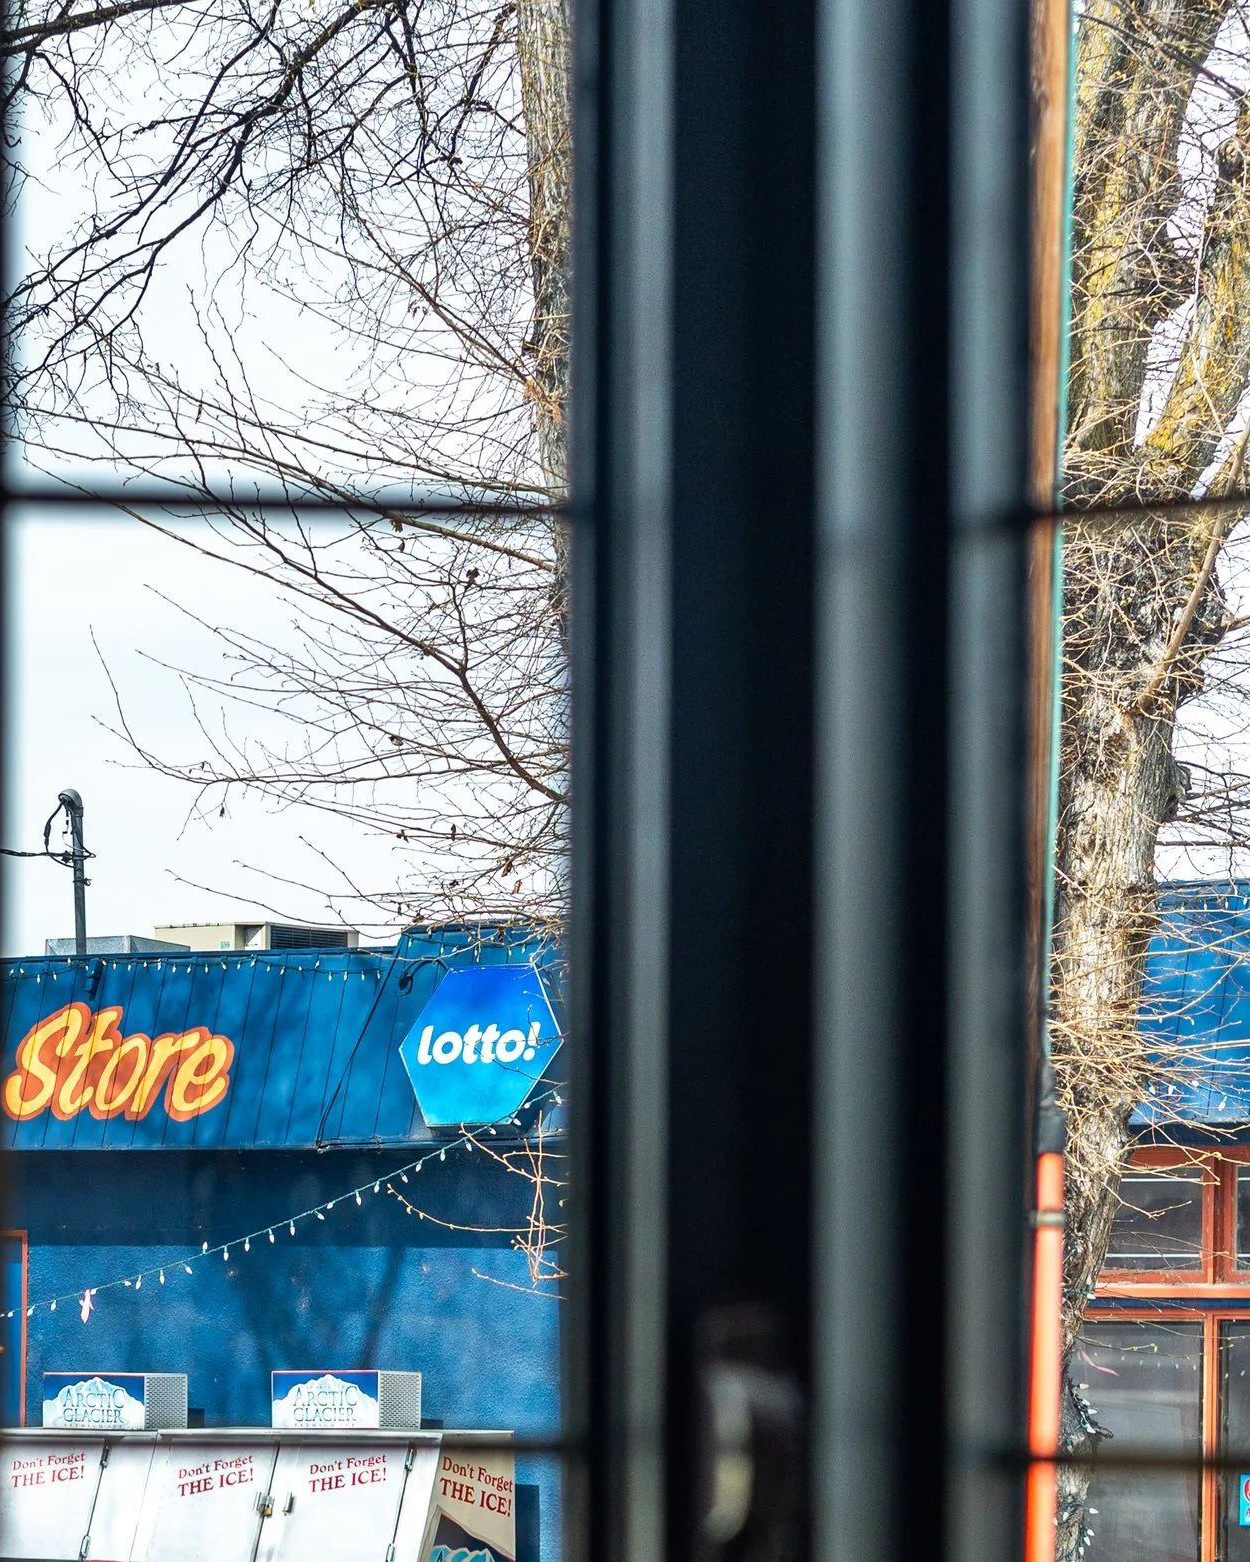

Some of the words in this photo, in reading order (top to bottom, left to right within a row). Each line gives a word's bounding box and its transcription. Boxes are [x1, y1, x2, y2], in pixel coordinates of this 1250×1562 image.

[417, 1021, 541, 1066] lotto!
[2, 1001, 235, 1123] Store
[62, 1387, 125, 1409] ARCTIC
[293, 1385, 358, 1407] ARCTIC
[62, 1407, 124, 1424] GLACIER
[293, 1407, 357, 1422] GLACIER
[13, 1457, 44, 1471] Don't
[47, 1451, 86, 1466] Forget
[178, 1464, 211, 1480] Don't
[213, 1455, 254, 1471] Forget
[309, 1460, 343, 1475] Don't
[346, 1454, 387, 1469] Forget
[11, 1470, 45, 1489] THE
[51, 1465, 85, 1483] ICE!
[178, 1477, 214, 1497] THE
[218, 1468, 254, 1489] ICE!
[308, 1473, 346, 1493] THE
[351, 1467, 387, 1487] ICE!
[442, 1455, 475, 1478] Don't
[477, 1466, 514, 1493] Forget
[439, 1476, 476, 1504] THE
[479, 1490, 513, 1518] ICE!
